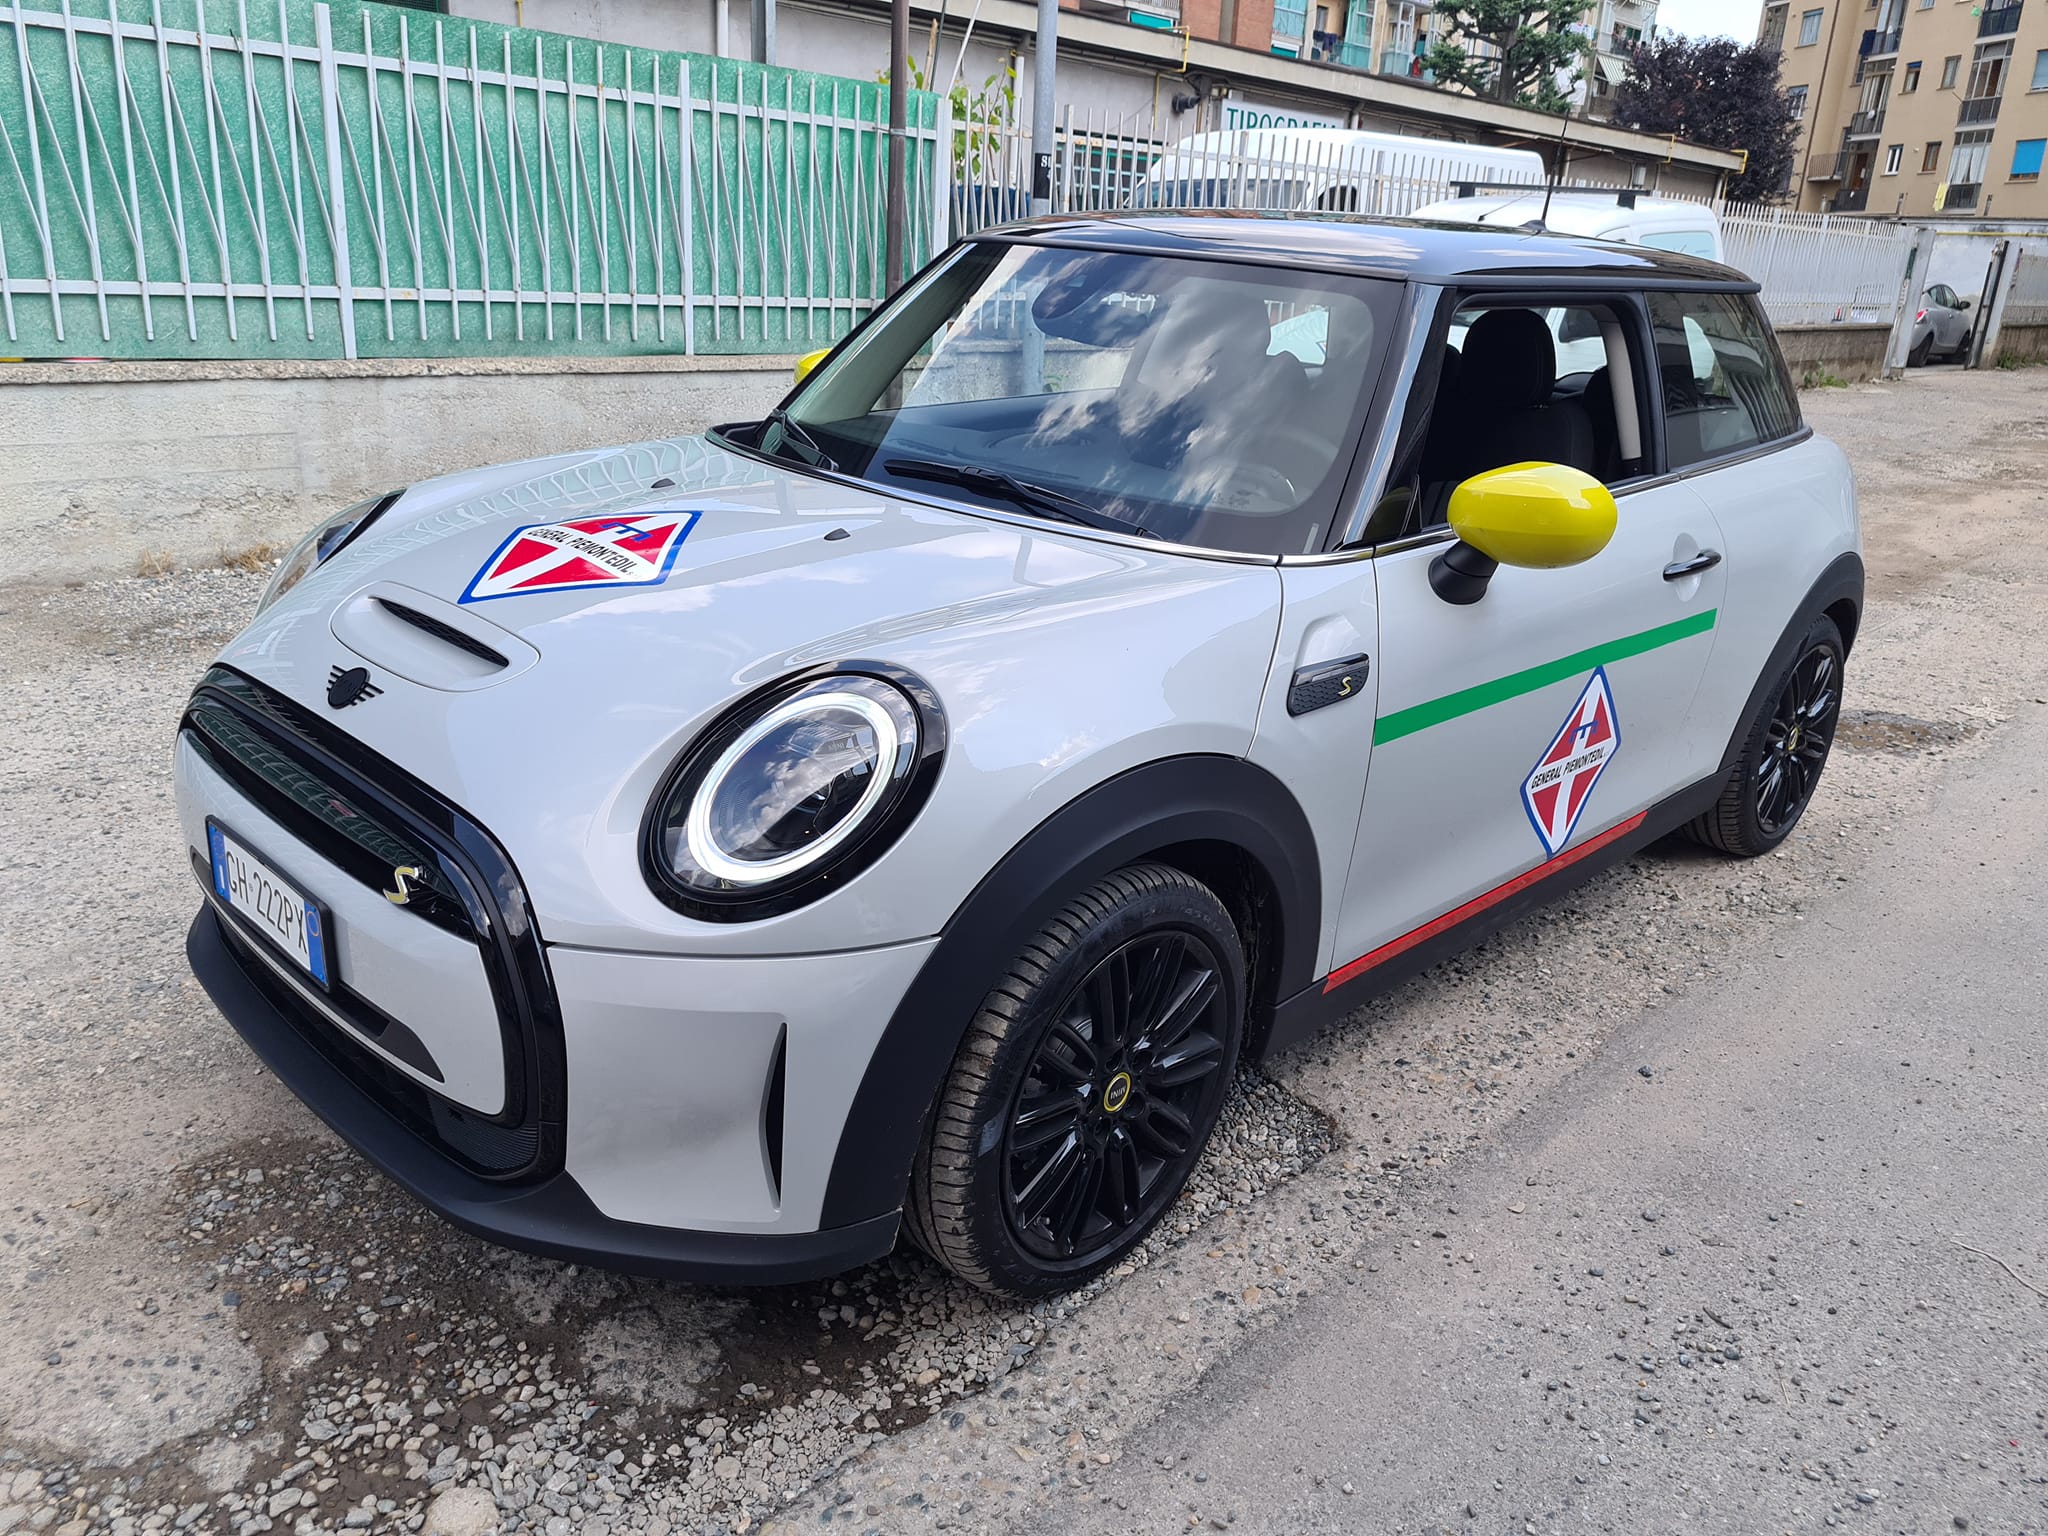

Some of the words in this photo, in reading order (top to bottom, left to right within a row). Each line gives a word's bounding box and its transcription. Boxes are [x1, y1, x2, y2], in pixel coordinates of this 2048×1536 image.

[527, 528, 573, 544] GENERAL
[565, 537, 638, 573] PIEMONTEDIL
[1338, 676, 1352, 696] S
[1531, 765, 1563, 789] GENERAL
[1563, 746, 1605, 776] PIEMONTEDIL
